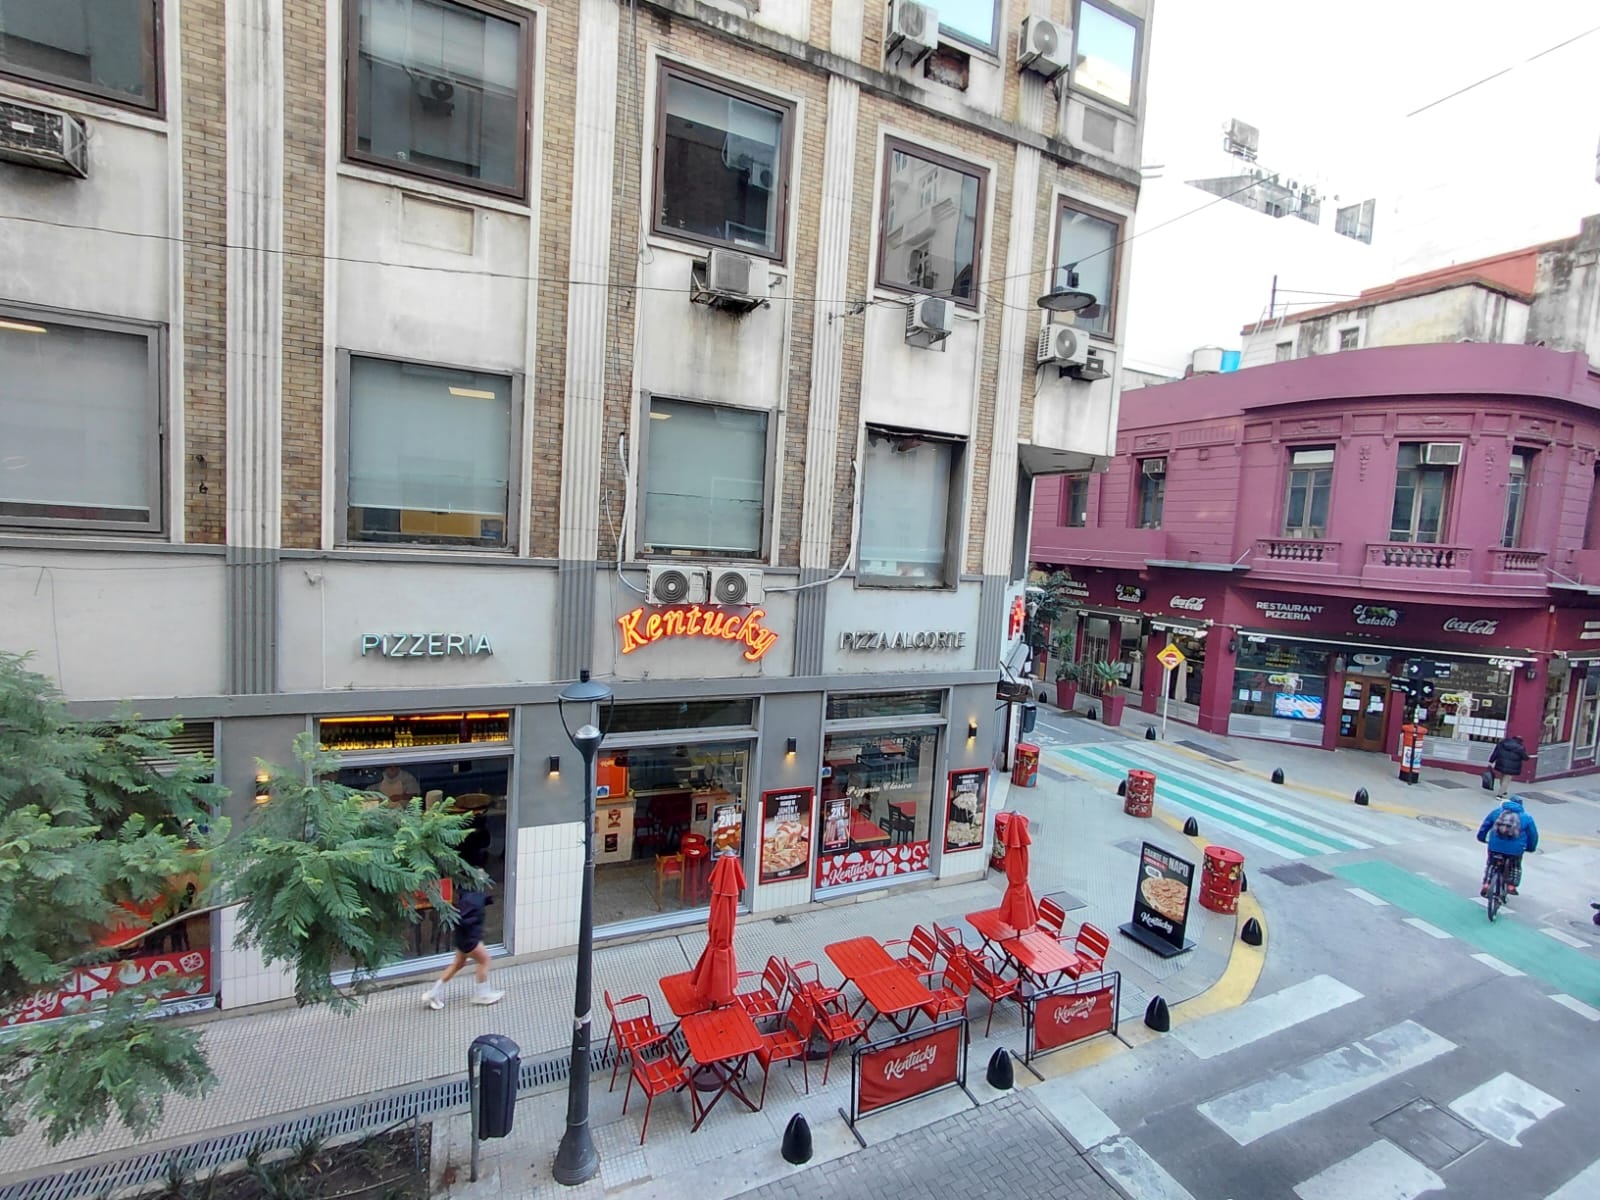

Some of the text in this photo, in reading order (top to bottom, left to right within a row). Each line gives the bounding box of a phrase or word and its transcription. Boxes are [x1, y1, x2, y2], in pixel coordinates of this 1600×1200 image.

[1256, 602, 1324, 614] RESTAURANT
[1265, 611, 1311, 621] PIZZERIA
[1353, 605, 1367, 616] El
[1357, 615, 1397, 627] Establo
[361, 632, 493, 657] PIZZERIA
[617, 606, 779, 662] Kentucky
[839, 631, 889, 649] PIZZA
[829, 860, 875, 884] Kentucky
[1168, 857, 1189, 878] NAPO
[1054, 996, 1097, 1025] Kentucky
[884, 1044, 937, 1081] Kentucky
